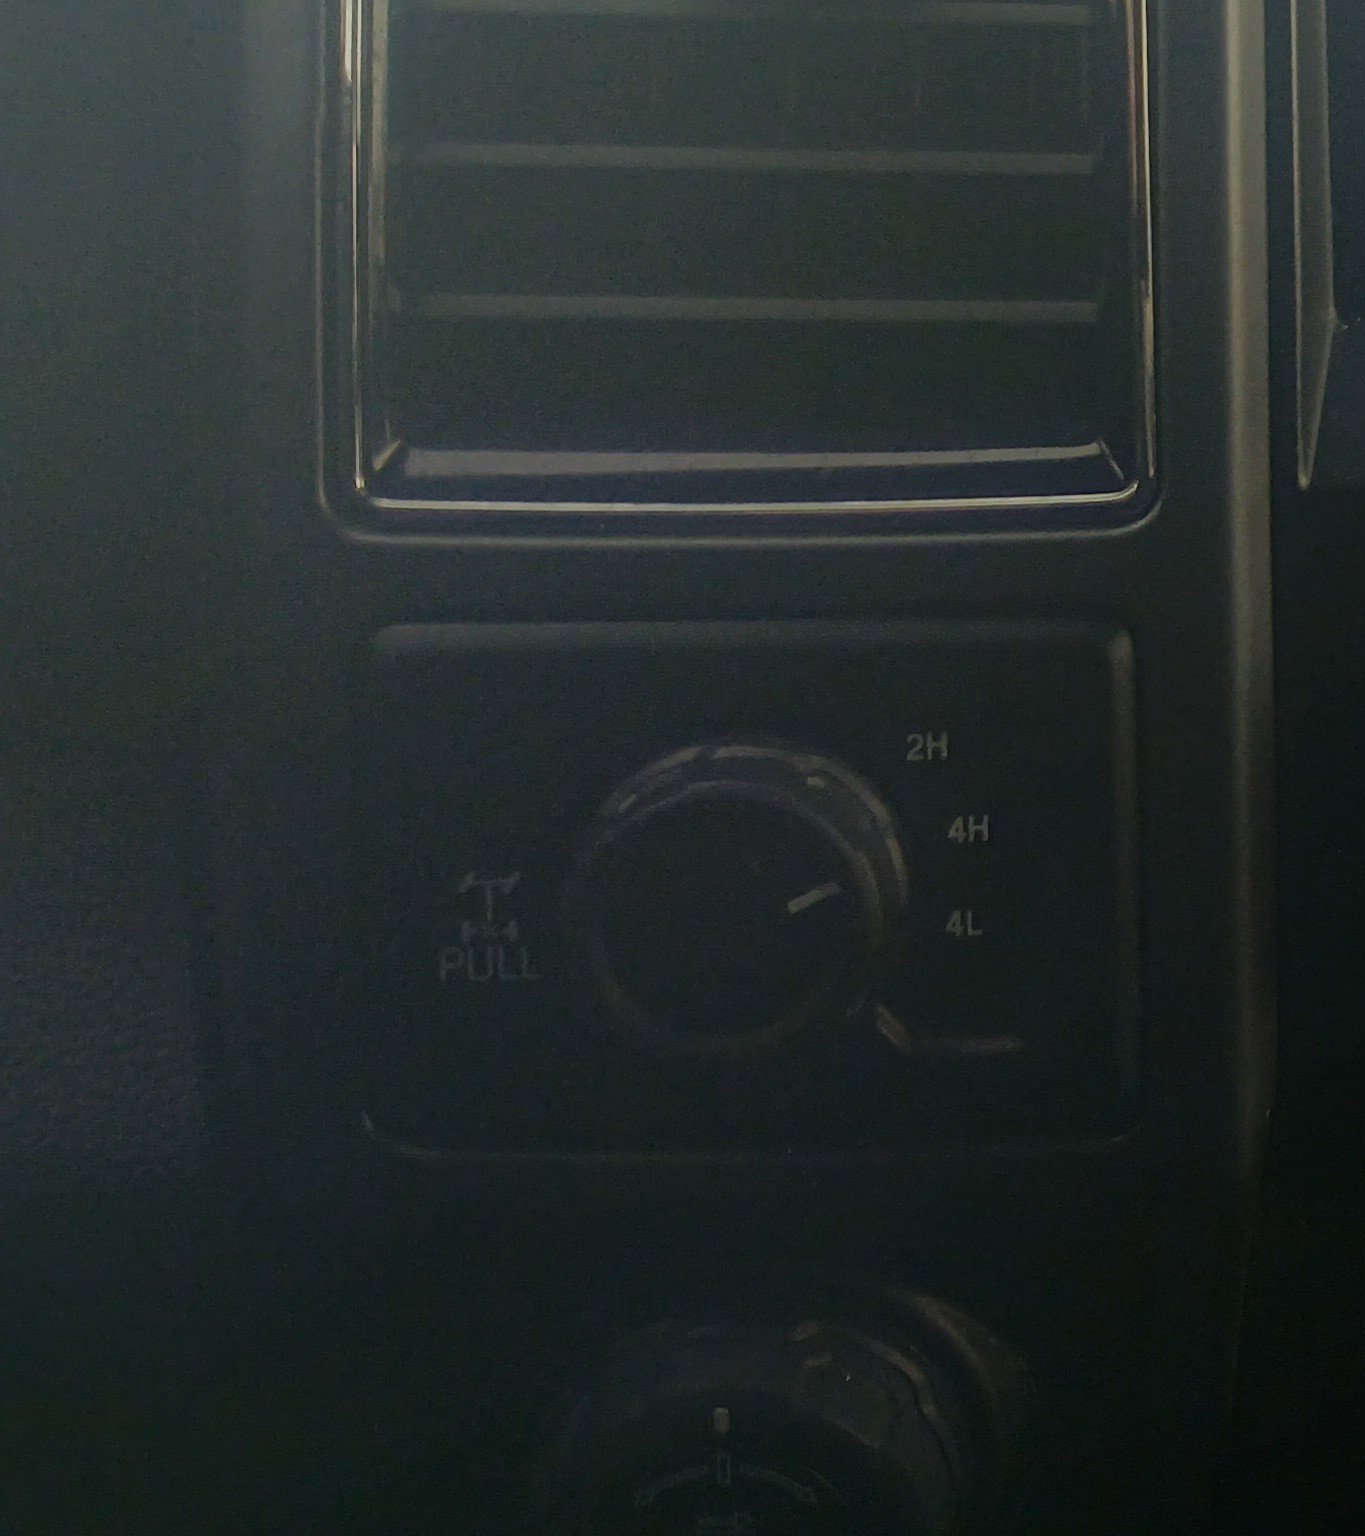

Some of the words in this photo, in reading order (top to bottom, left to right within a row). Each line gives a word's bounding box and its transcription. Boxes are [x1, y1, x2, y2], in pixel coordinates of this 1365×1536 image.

[906, 732, 948, 761] 2H
[948, 815, 990, 843] 4H
[945, 911, 983, 937] 4L
[440, 947, 543, 982] PULL
